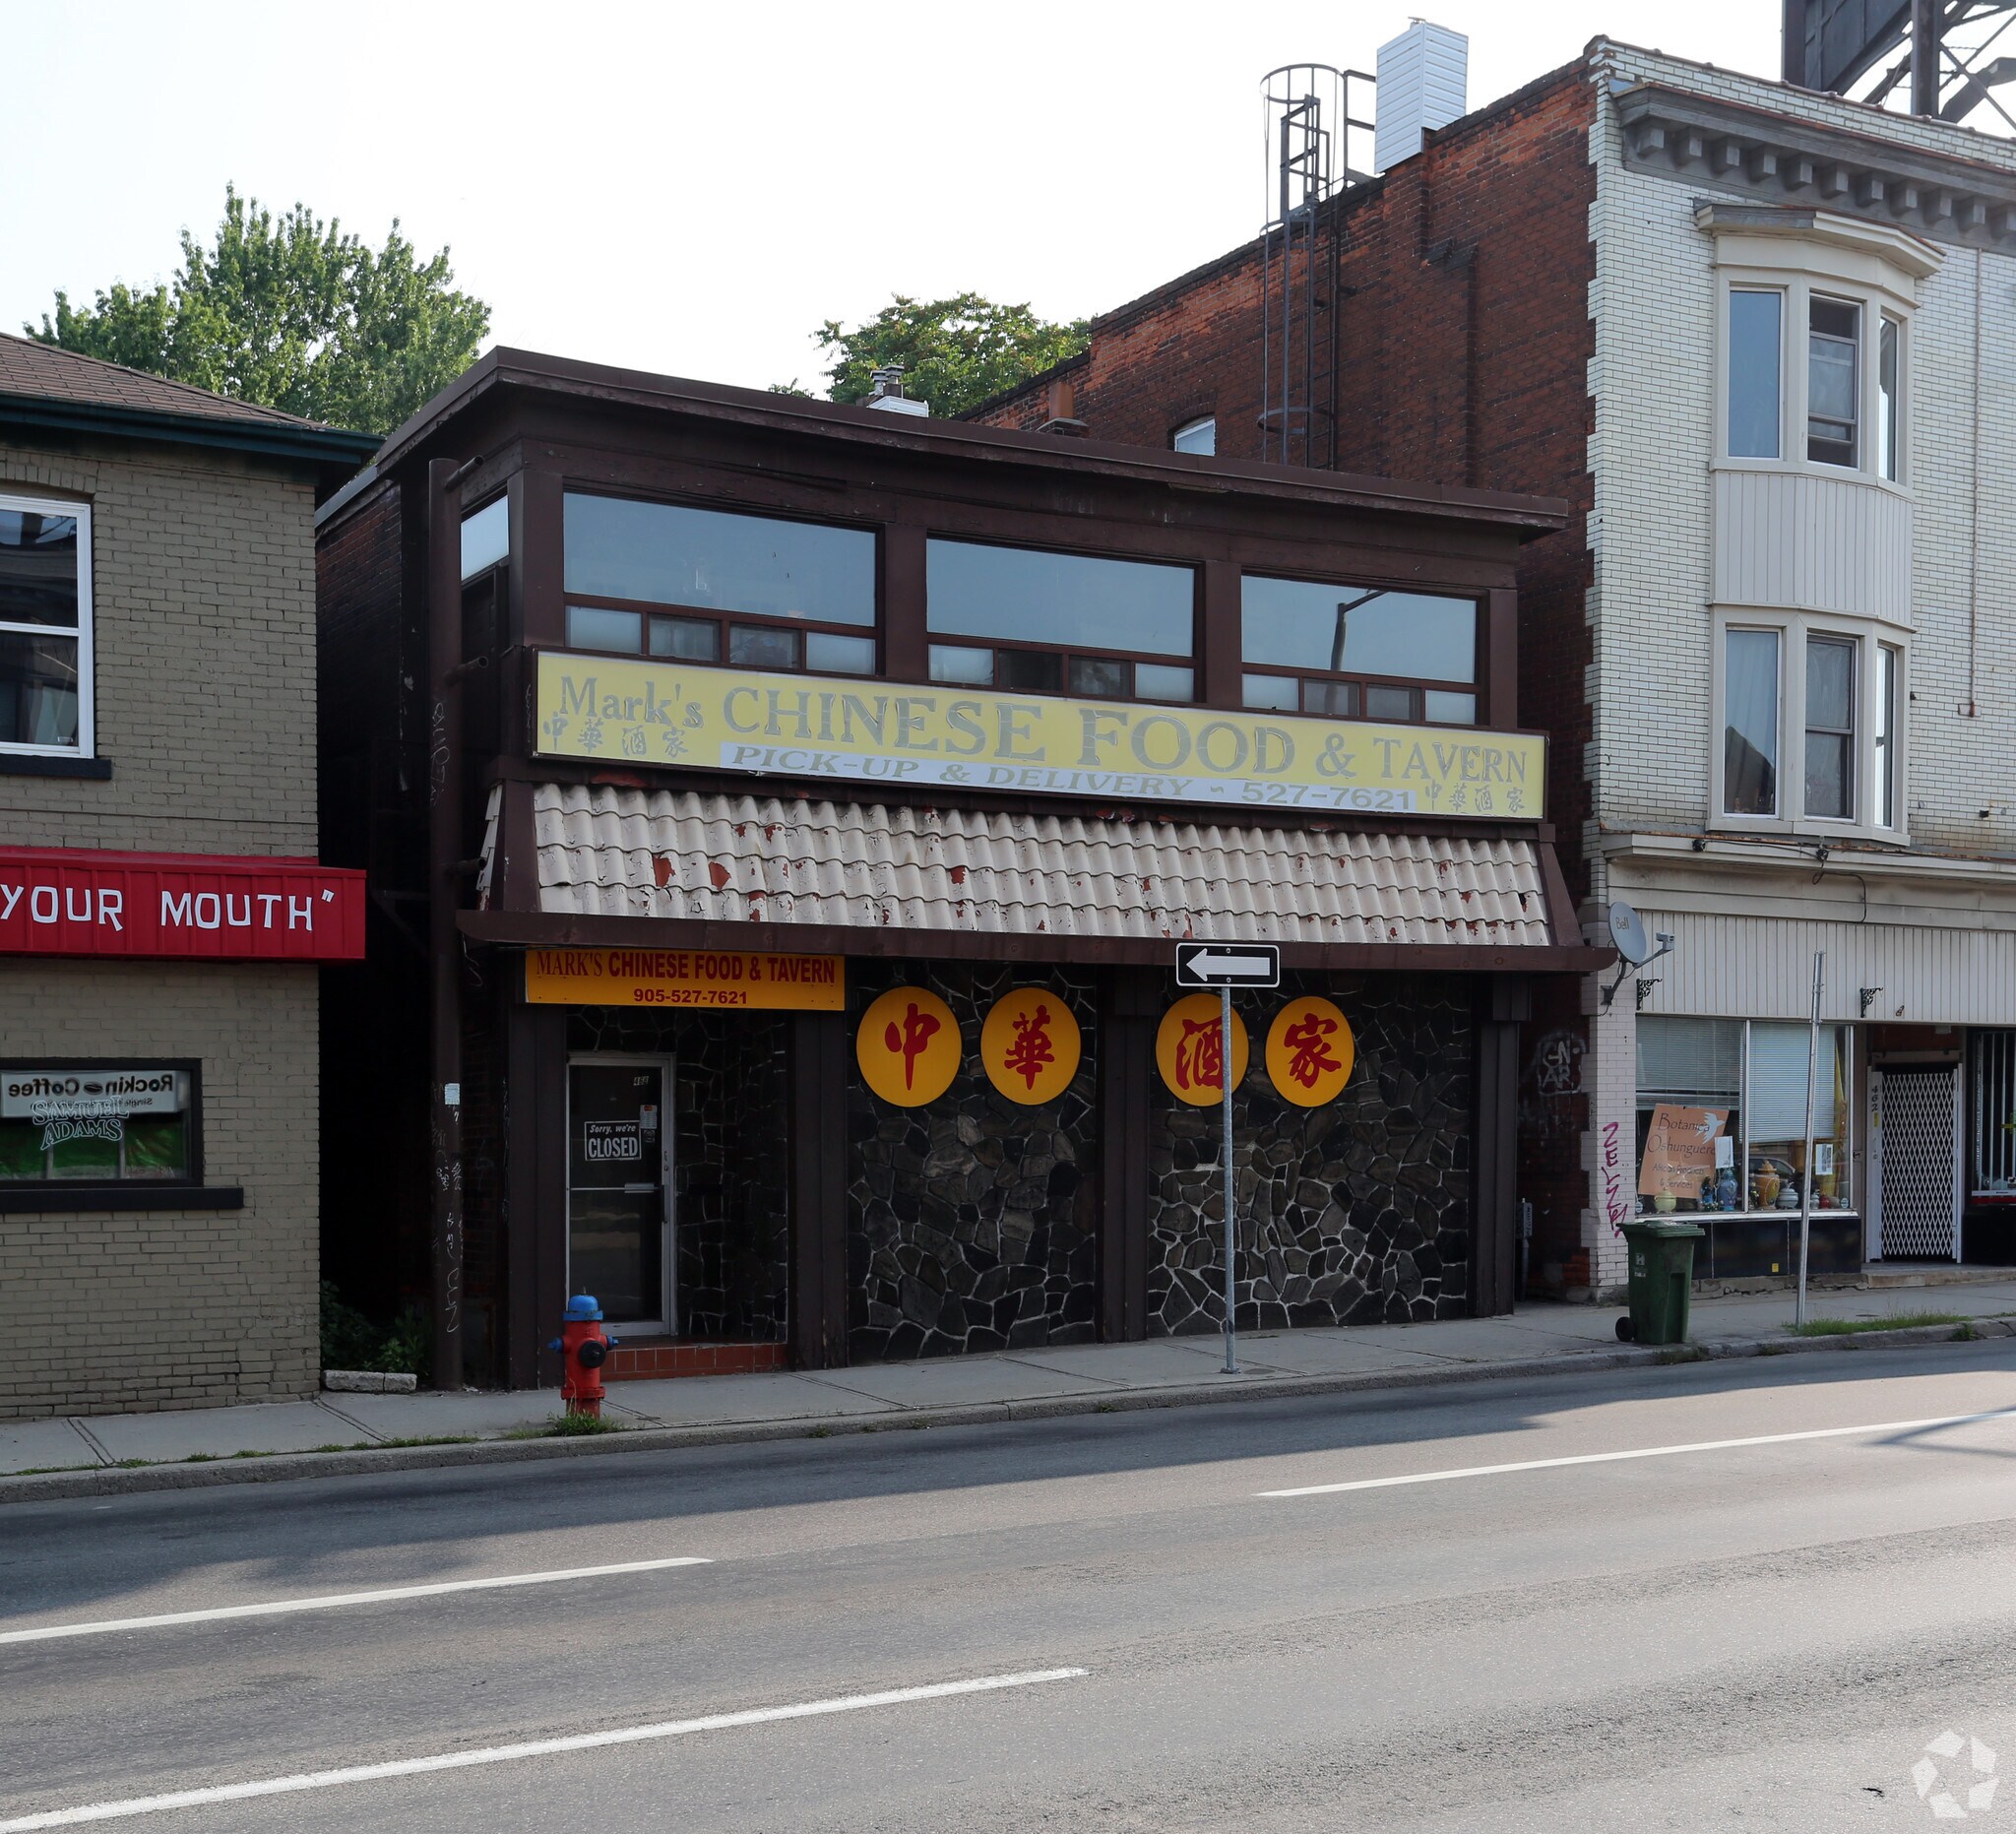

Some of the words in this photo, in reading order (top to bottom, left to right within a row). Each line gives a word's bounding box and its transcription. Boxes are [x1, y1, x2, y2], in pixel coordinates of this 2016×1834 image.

[560, 676, 704, 728] Mark's
[723, 687, 1046, 761] CHINESE
[1078, 709, 1295, 775] FOOD
[1316, 732, 1356, 779] &
[1373, 737, 1528, 783] TAVERN
[732, 746, 919, 778] PICK-UP
[939, 764, 971, 783] &
[986, 767, 1194, 795] DELIVERY
[1241, 782, 1410, 809] 527-7621
[0, 884, 123, 931] YOUR
[1615, 917, 1630, 930] Bell
[536, 951, 602, 977] MARK'S
[608, 952, 689, 979] CHINESE
[695, 954, 743, 980] FOOD
[749, 956, 762, 980] &
[767, 957, 835, 983] TAVERN
[634, 988, 747, 1004] 905-527-7621
[32, 1096, 130, 1125] SAMUEL
[1658, 1112, 1710, 1132] Botanica
[40, 1119, 123, 1151] ADAMS
[590, 1124, 612, 1134] Sorry,
[588, 1137, 638, 1158] CLOSED
